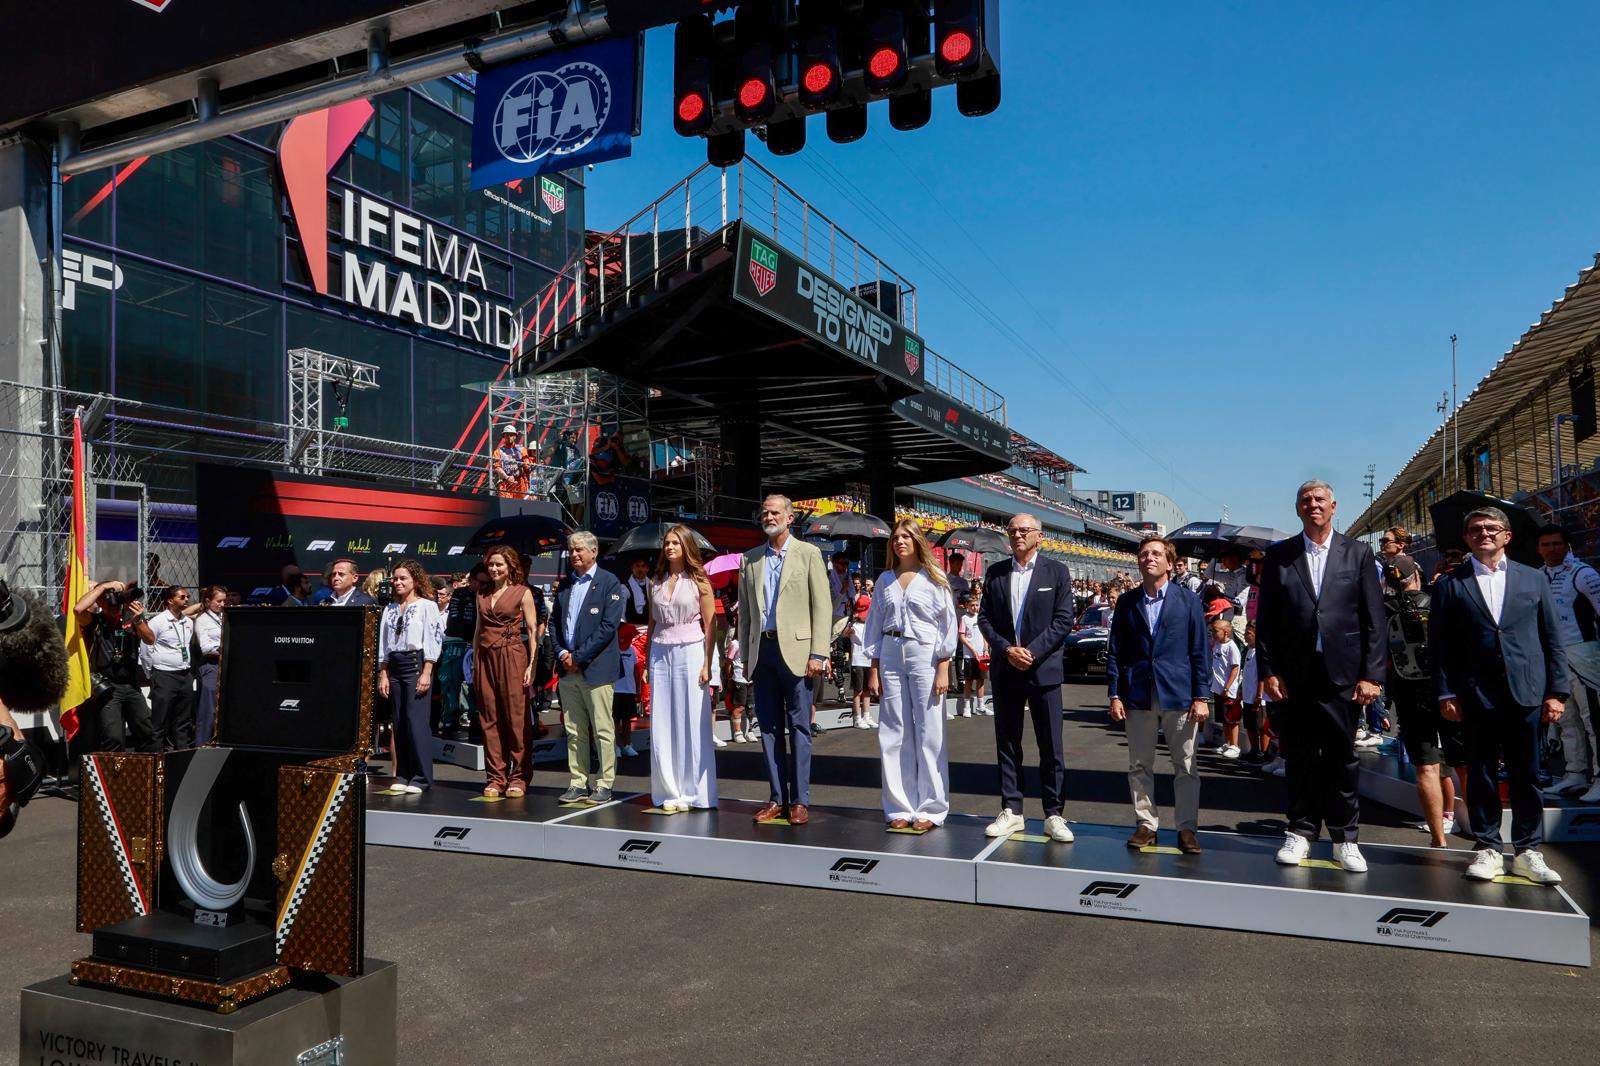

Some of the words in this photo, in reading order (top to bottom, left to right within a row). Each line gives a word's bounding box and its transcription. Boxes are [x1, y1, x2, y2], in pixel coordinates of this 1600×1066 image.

[543, 179, 563, 198] TAG
[543, 191, 564, 212] HEUER
[344, 189, 488, 291] IFEMA
[753, 244, 776, 269] TAG
[750, 262, 777, 293] HEUER
[344, 251, 519, 350] MADRID
[797, 266, 893, 346] DESIGNED
[813, 307, 840, 343] TO
[845, 324, 878, 364] WIN
[906, 338, 919, 355] TAG
[904, 352, 920, 374] HEUER
[1115, 497, 1130, 509] 12
[306, 540, 336, 551] F1
[347, 538, 371, 552] Madrid
[382, 543, 408, 553] F1
[417, 541, 438, 555] Madrid
[447, 545, 466, 555] F
[274, 636, 291, 644] LOUIS
[291, 636, 315, 644] VUITTON
[433, 826, 472, 840] F1
[618, 838, 662, 854] F1
[829, 857, 880, 874] F1
[1080, 881, 1140, 899] F1
[1376, 907, 1450, 928] F1
[39, 1030, 106, 1062] VICTORY
